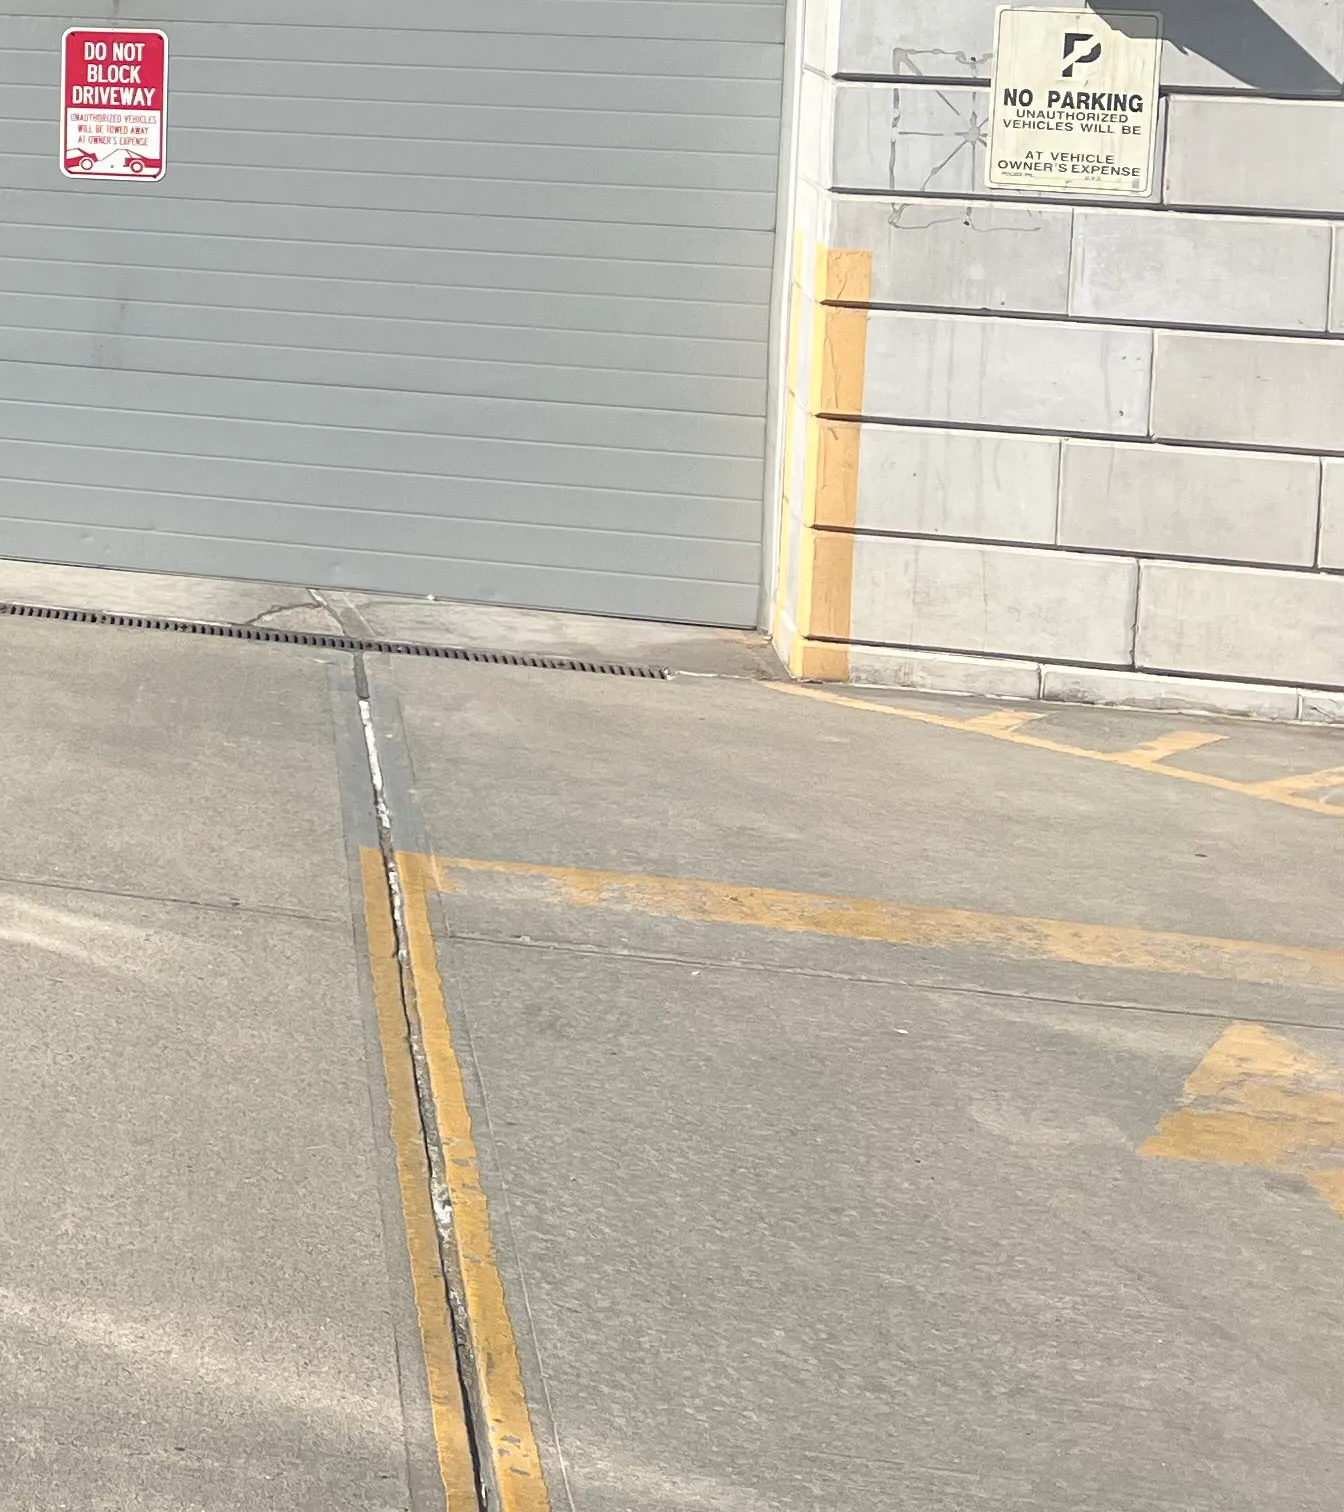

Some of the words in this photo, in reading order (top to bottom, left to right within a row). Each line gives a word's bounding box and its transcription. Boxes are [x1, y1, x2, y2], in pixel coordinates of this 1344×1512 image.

[83, 41, 107, 61] DO
[112, 42, 145, 62] NOT
[86, 63, 142, 84] BLOCK
[72, 85, 156, 107] DRIVEWAY
[1003, 88, 1033, 107] NO
[1047, 90, 1144, 113] PARKING
[1016, 109, 1129, 124] UNAUTHORIZED
[1003, 119, 1074, 132] VEHICLES
[1080, 123, 1115, 134] WILL
[1121, 125, 1142, 135] BE
[1025, 150, 1043, 161] AT
[1050, 151, 1115, 165] VEHICLE
[997, 160, 1068, 173] OWNER'S
[1071, 164, 1141, 177] EXPENSE
